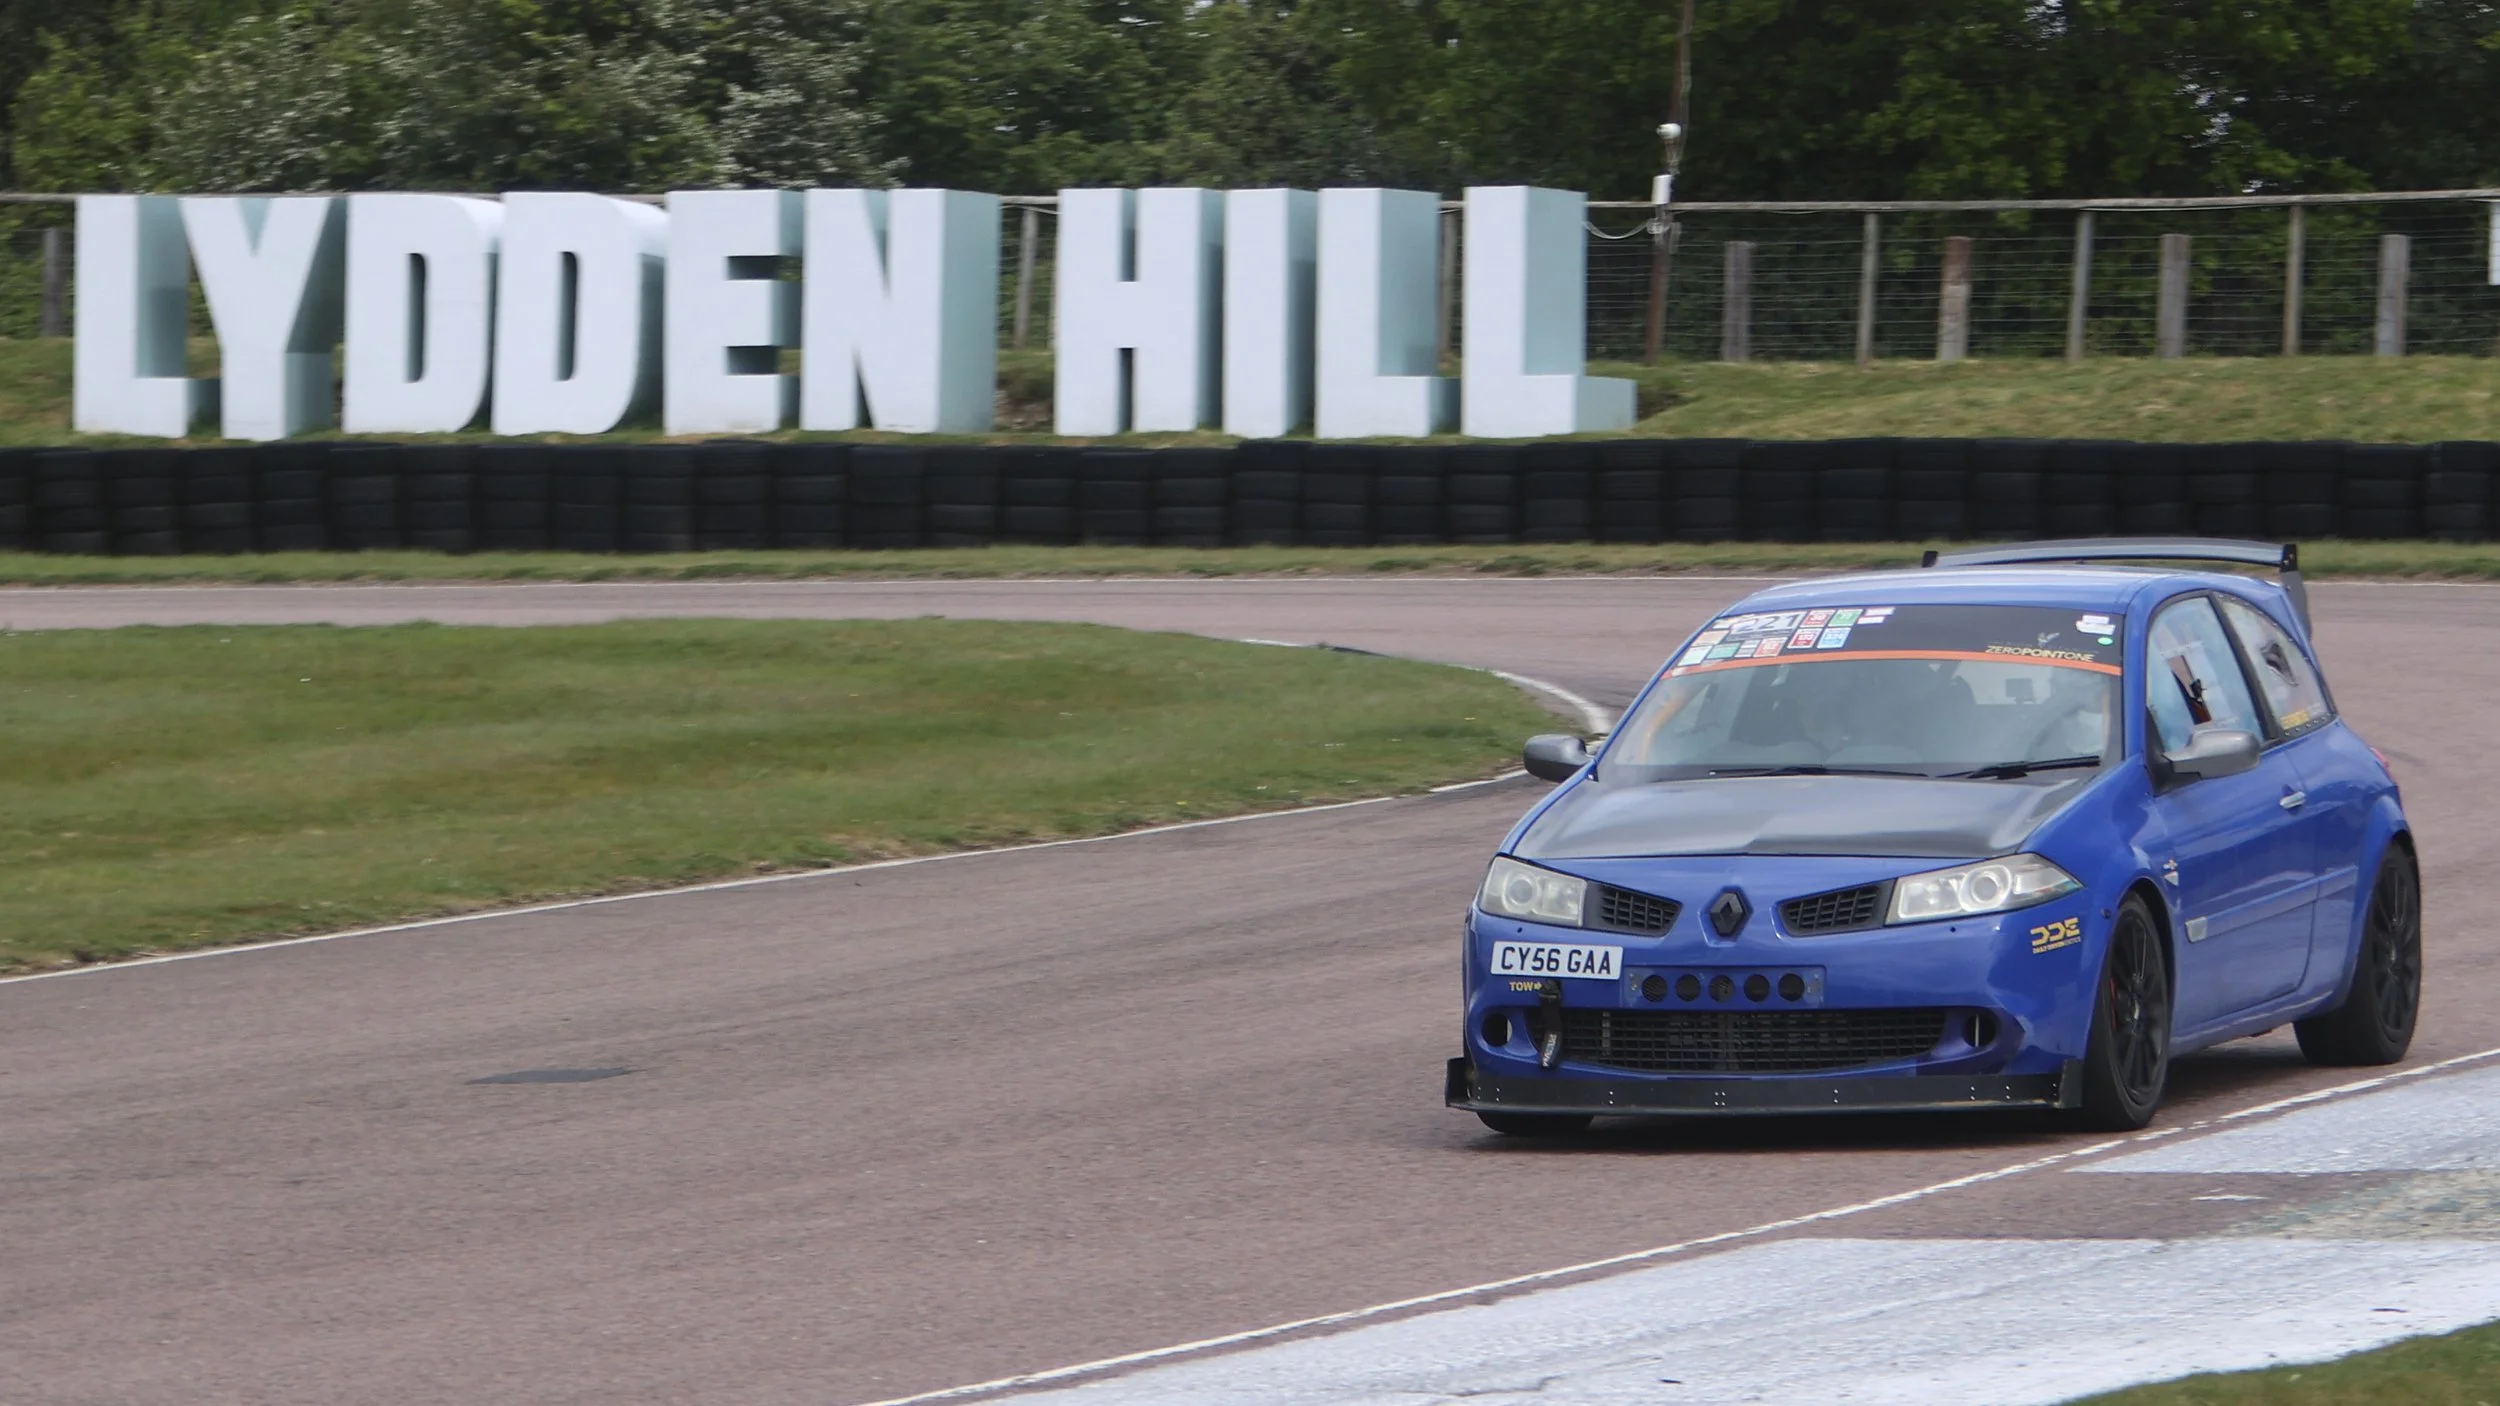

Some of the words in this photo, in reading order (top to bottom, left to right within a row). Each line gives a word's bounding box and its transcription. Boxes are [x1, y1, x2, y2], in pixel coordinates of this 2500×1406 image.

[73, 189, 1000, 440] LYDDEN
[1053, 185, 1637, 438] HILL
[1985, 645, 2096, 662] ZEROPOINTONE
[1501, 946, 1560, 972] CY56
[1567, 949, 1611, 975] GAA
[1509, 981, 1534, 992] TOW
